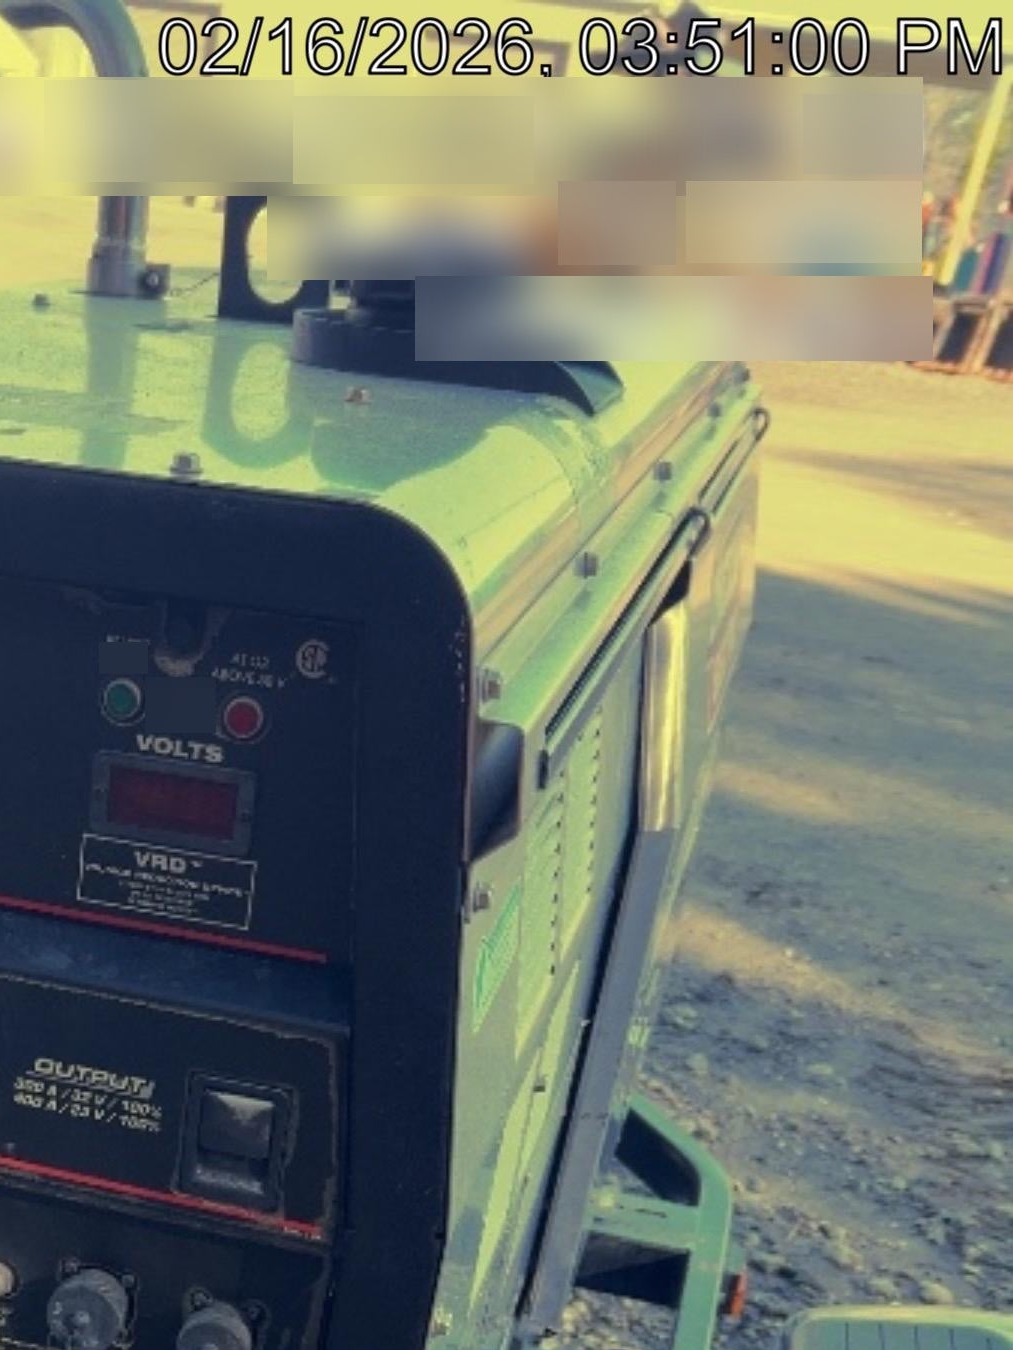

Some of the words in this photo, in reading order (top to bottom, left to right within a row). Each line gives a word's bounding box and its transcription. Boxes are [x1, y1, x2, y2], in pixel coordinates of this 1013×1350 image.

[136, 733, 224, 763] VOLTS
[134, 851, 187, 874] VRD
[34, 1057, 148, 1093] OUTPUT
